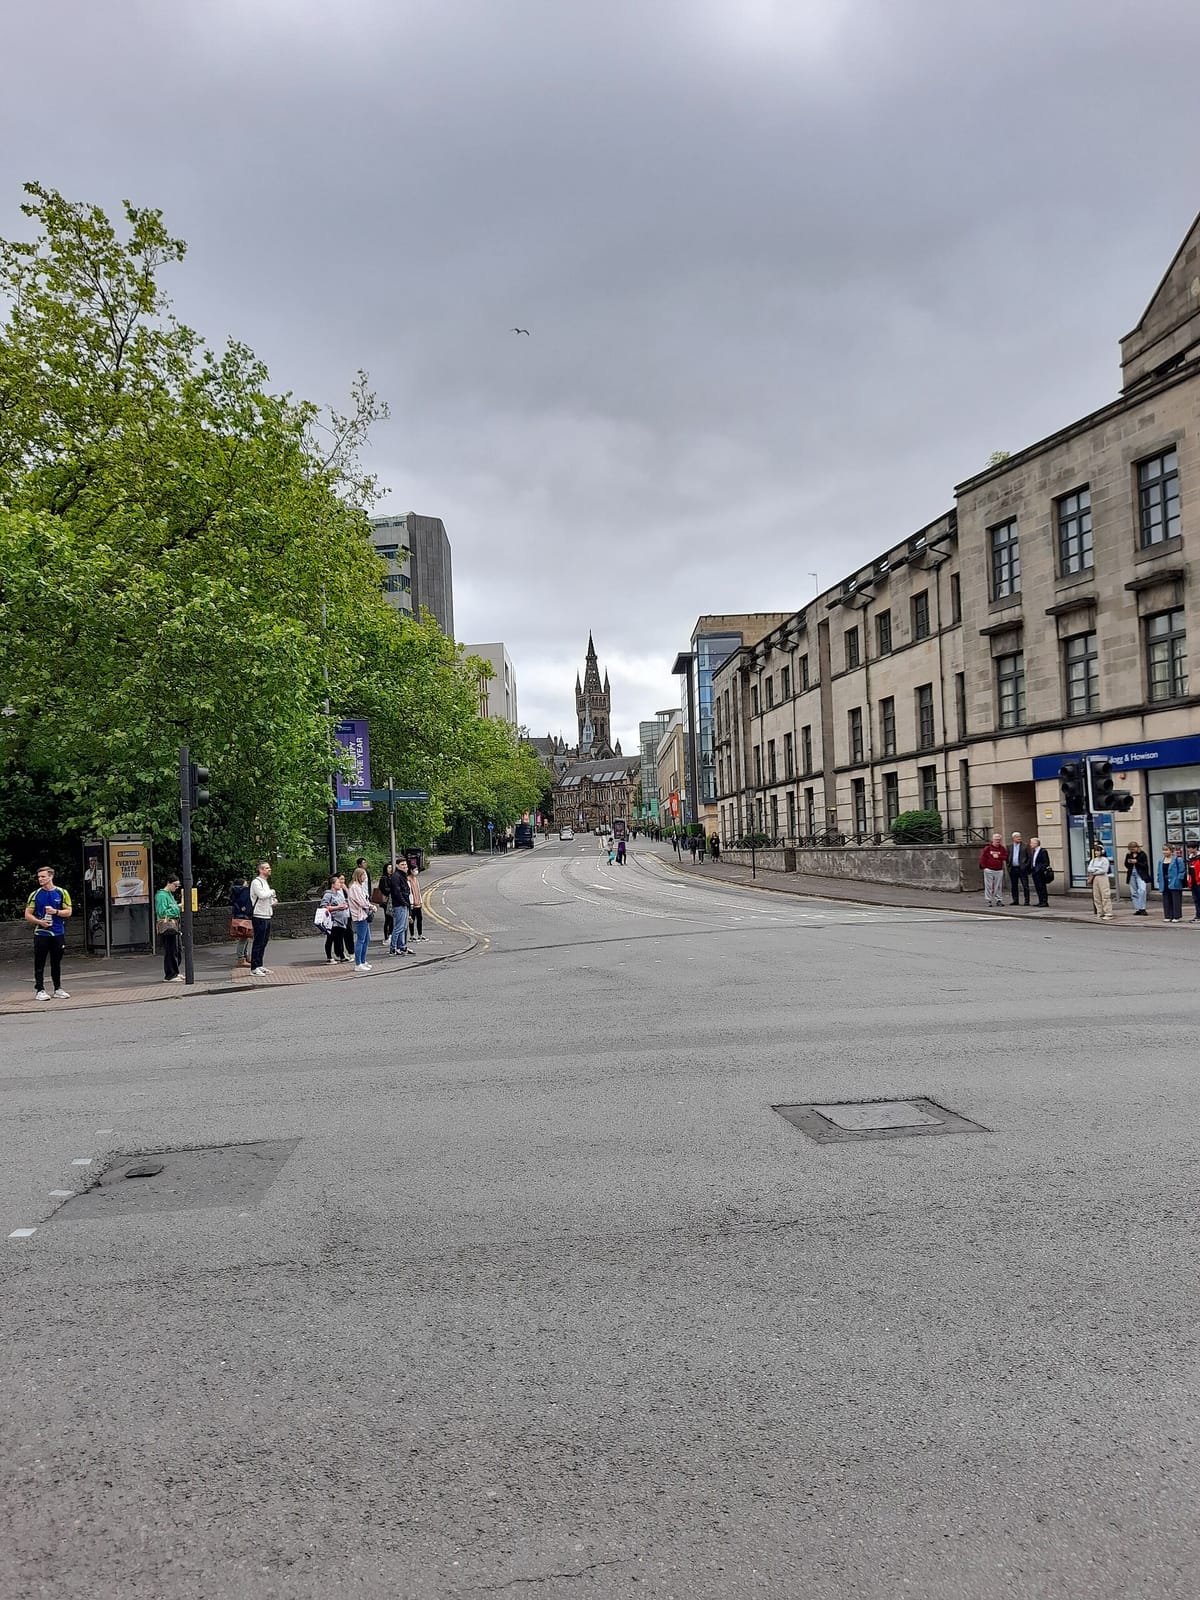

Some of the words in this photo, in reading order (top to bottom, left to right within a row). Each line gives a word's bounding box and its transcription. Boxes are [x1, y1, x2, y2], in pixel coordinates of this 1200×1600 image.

[356, 737, 364, 758] YEAR
[1124, 754, 1130, 762] &
[1130, 751, 1159, 761] Howison
[349, 742, 357, 787] UESITY
[356, 760, 364, 775] THE
[357, 776, 365, 787] OF
